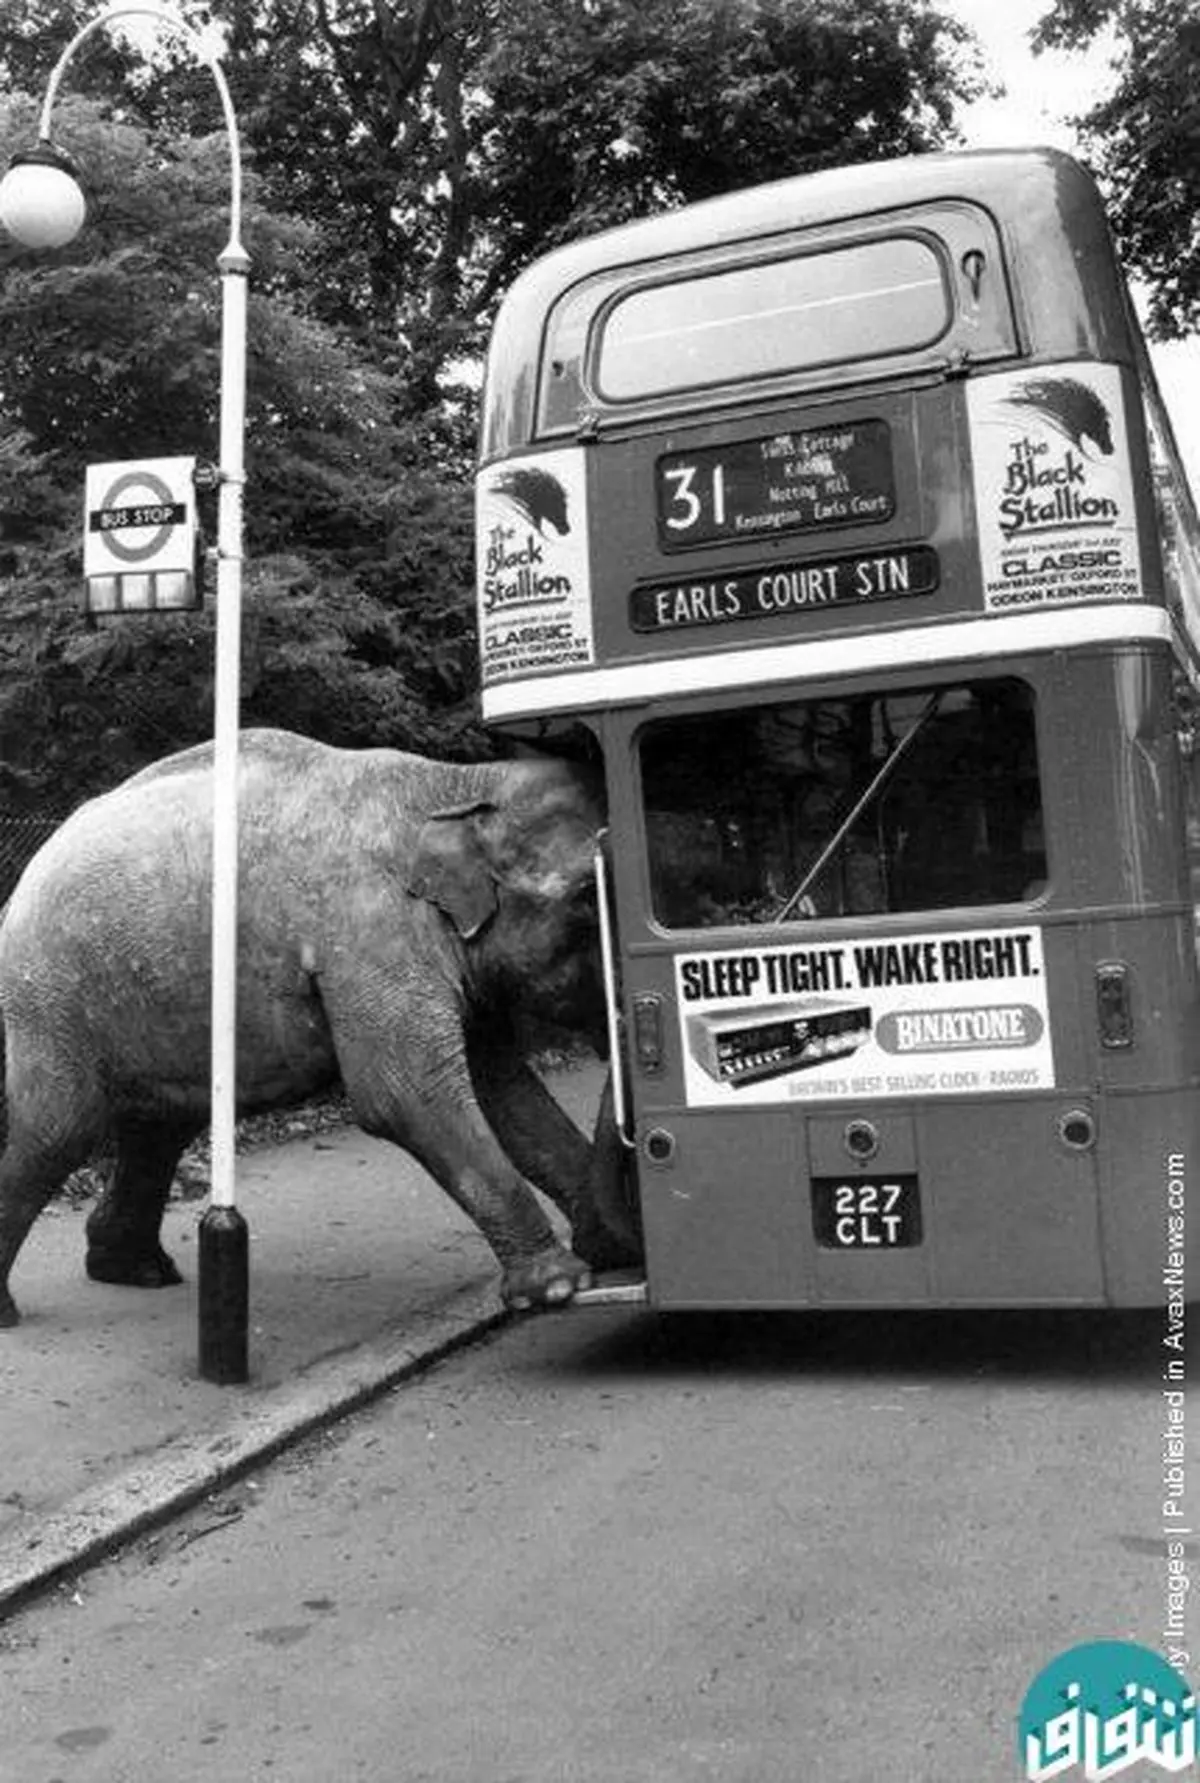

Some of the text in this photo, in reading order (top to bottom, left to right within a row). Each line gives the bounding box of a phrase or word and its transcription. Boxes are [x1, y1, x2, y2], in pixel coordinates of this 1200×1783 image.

[1010, 438, 1048, 461] The
[1003, 451, 1085, 496] Black
[101, 507, 173, 528] BUS STOP
[664, 464, 725, 531] 31
[851, 496, 887, 514] Court
[999, 486, 1120, 531] Stallion
[485, 535, 543, 577] Black
[1002, 550, 1122, 577] CLASSIC
[483, 567, 571, 610] Stallion
[655, 556, 909, 626] EARLS COURT STN
[681, 933, 1040, 1000] SLEEP TIGHT. WAKE RIGHT.
[897, 1009, 1026, 1050] BINATONE
[835, 1185, 901, 1214] 227
[835, 1217, 901, 1244] CLT
